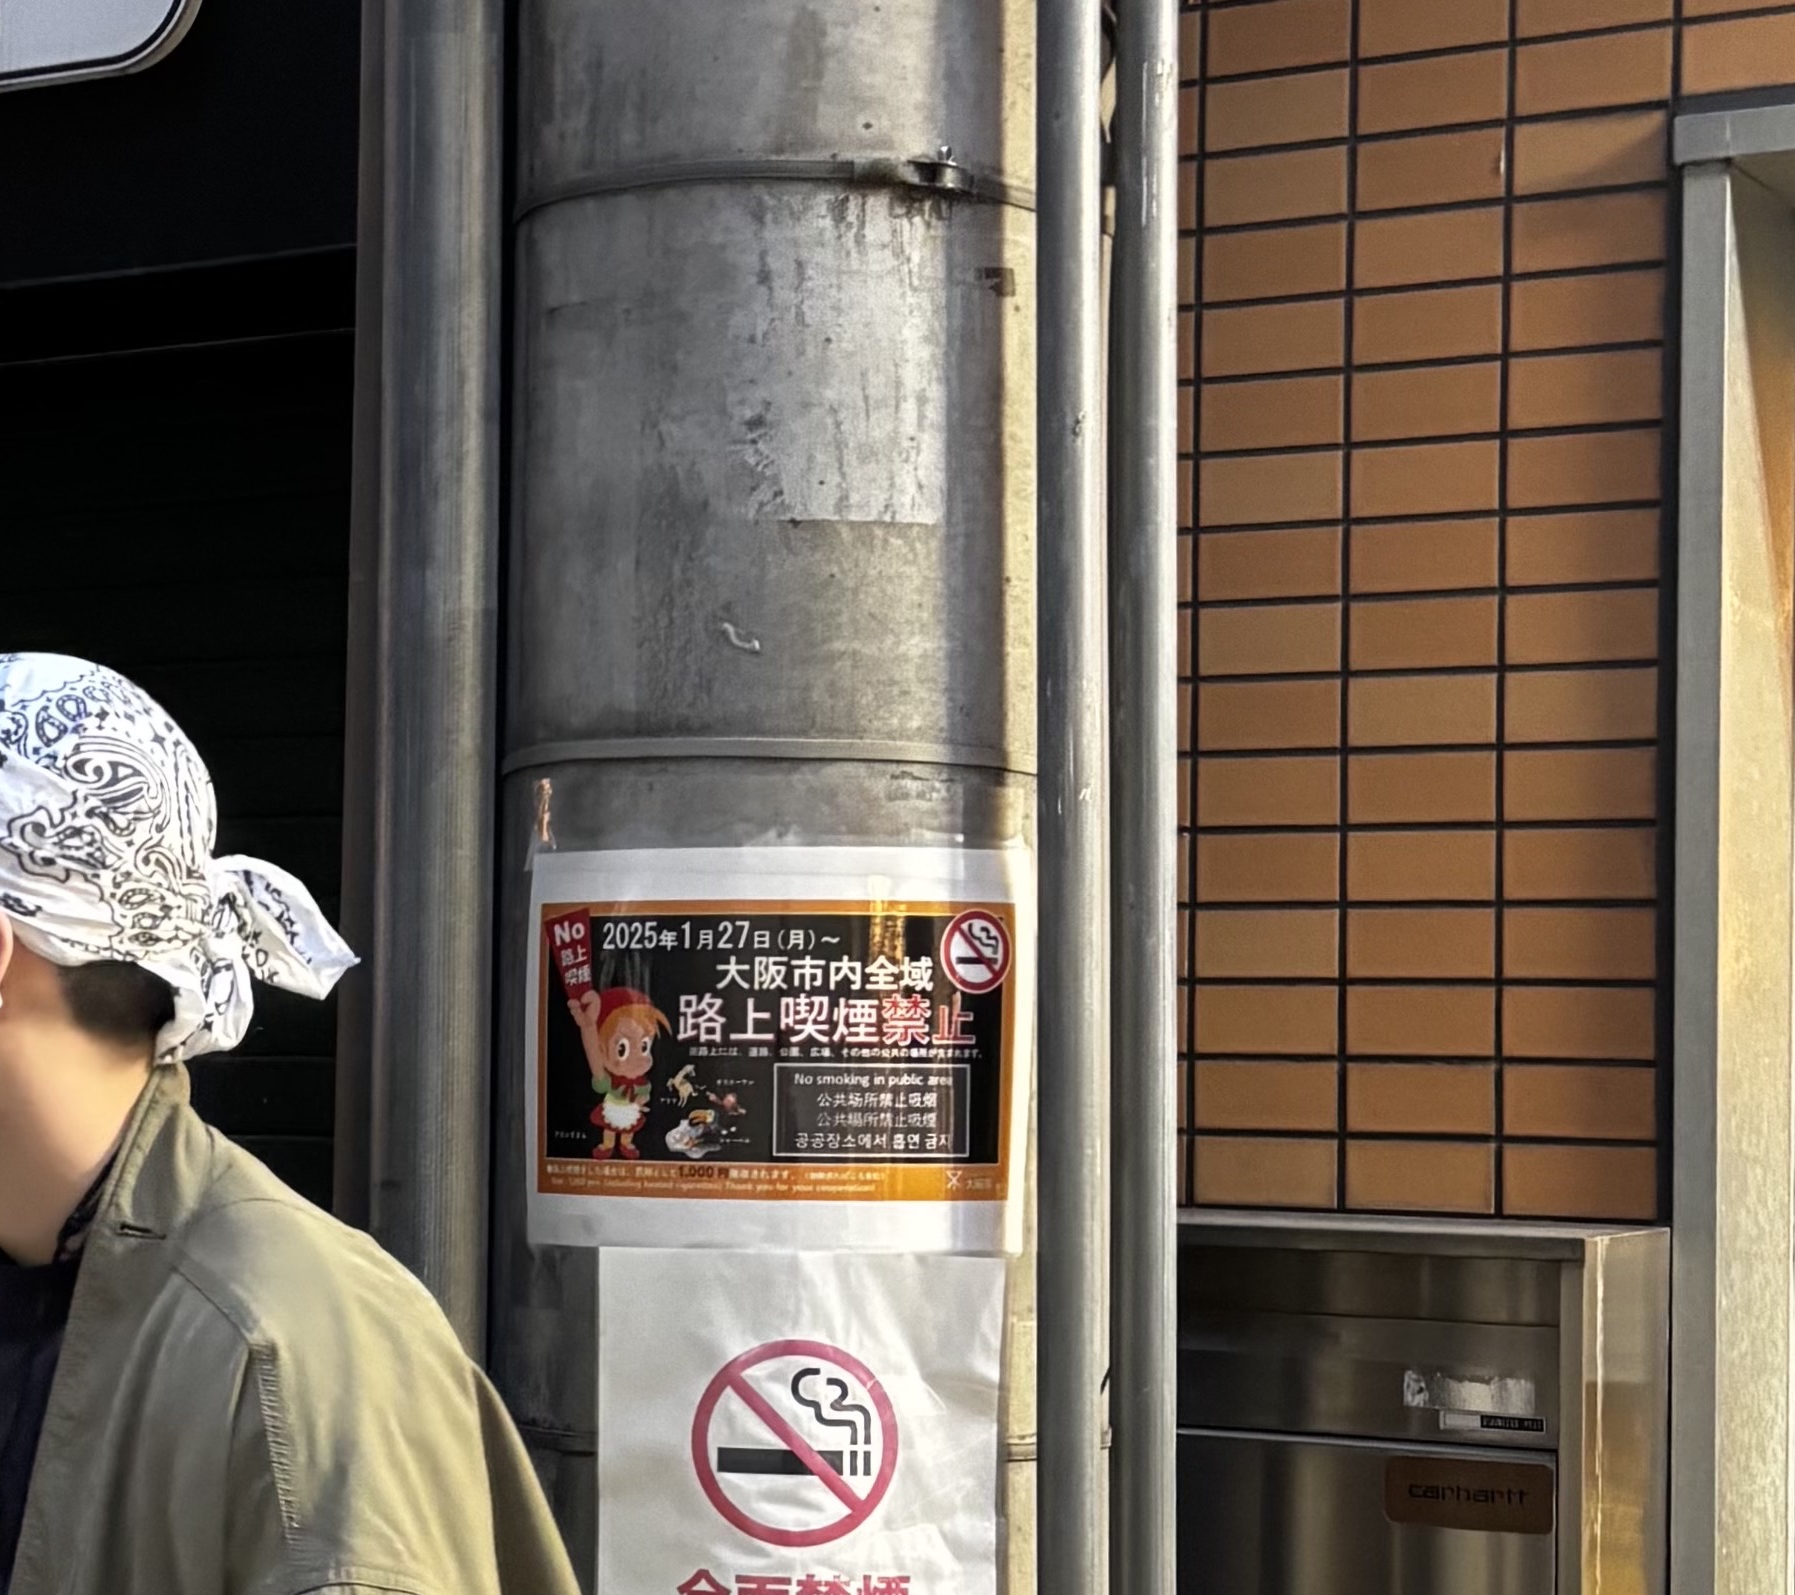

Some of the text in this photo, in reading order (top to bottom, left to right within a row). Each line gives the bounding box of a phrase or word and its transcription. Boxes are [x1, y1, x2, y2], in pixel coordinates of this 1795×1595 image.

[553, 921, 586, 947] No
[715, 955, 935, 992] 大阪市内全域
[677, 993, 976, 1046] 路上喫煙禁止
[794, 1073, 813, 1085] No
[816, 1073, 870, 1088] smoking
[873, 1073, 886, 1086] in
[888, 1073, 925, 1088] public
[794, 1132, 887, 1149] 공공장소에서
[924, 1133, 952, 1150] 금지
